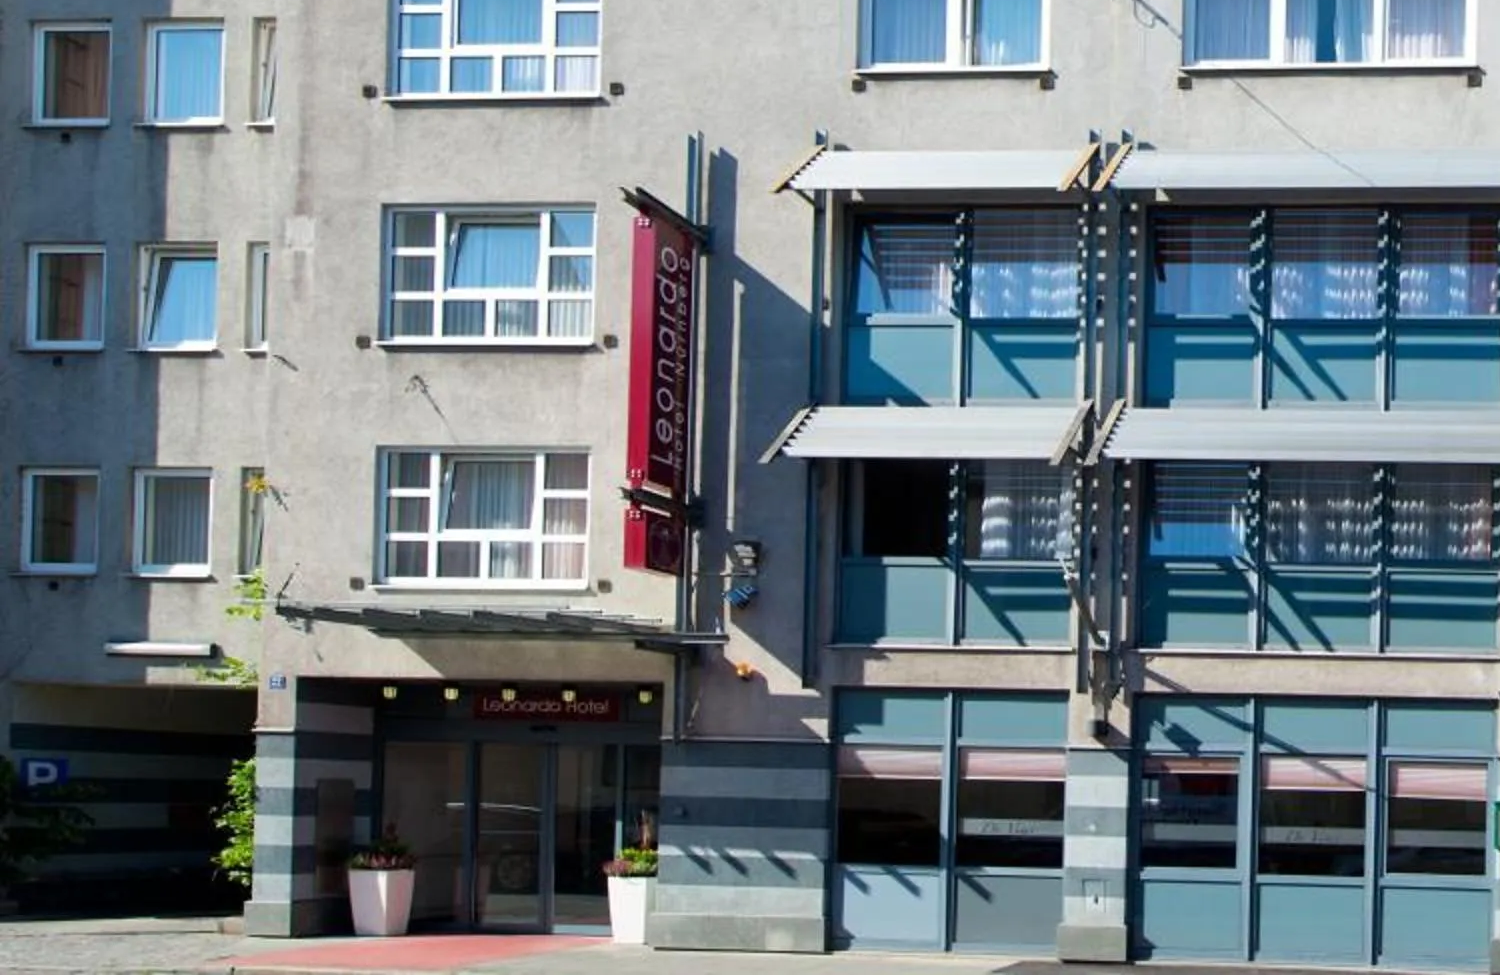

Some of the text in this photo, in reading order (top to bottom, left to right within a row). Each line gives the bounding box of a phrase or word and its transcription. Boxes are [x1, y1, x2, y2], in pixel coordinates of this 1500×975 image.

[650, 246, 679, 465] Leonardo
[673, 400, 686, 473] Hotel
[482, 697, 610, 715] Leonardo Hotel
[27, 760, 59, 786] P
